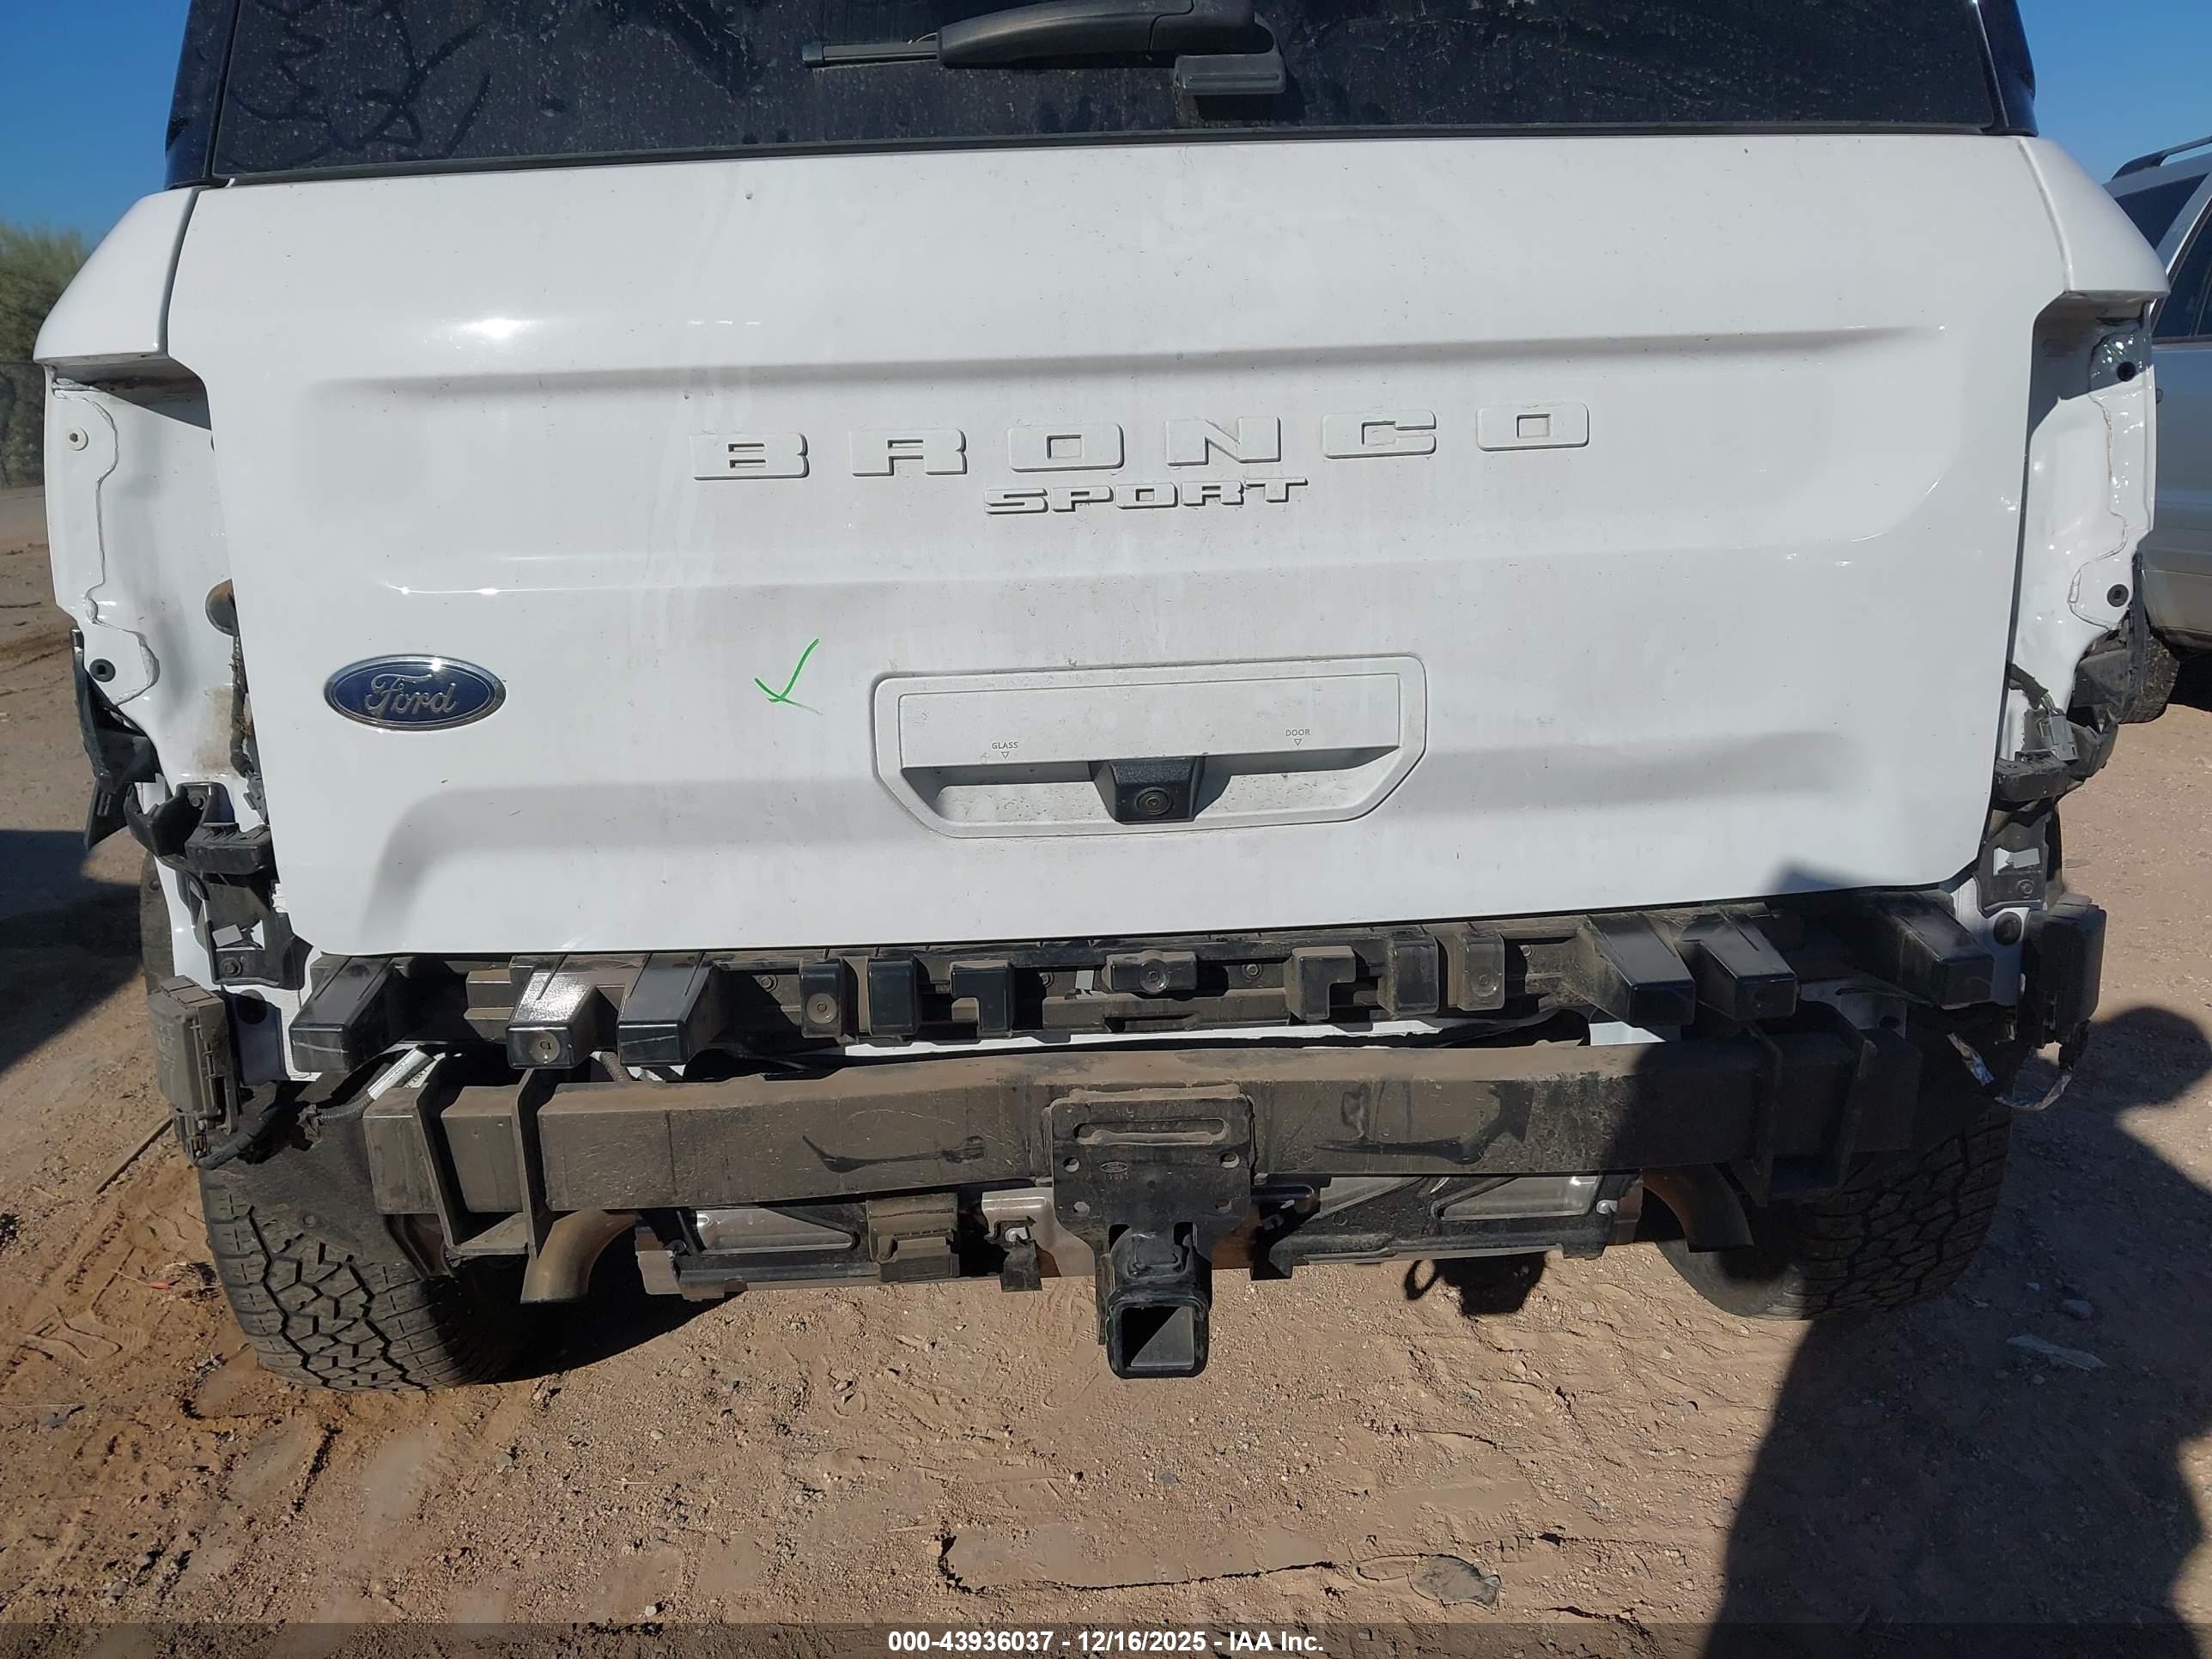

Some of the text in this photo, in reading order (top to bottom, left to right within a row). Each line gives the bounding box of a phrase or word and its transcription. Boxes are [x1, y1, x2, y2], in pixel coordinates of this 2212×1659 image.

[690, 402, 1589, 481] BRONCO
[984, 477, 1308, 514] SPORT
[363, 672, 458, 715] Ford
[991, 740, 1019, 750] GLASS
[1285, 728, 1311, 737] DOOR
